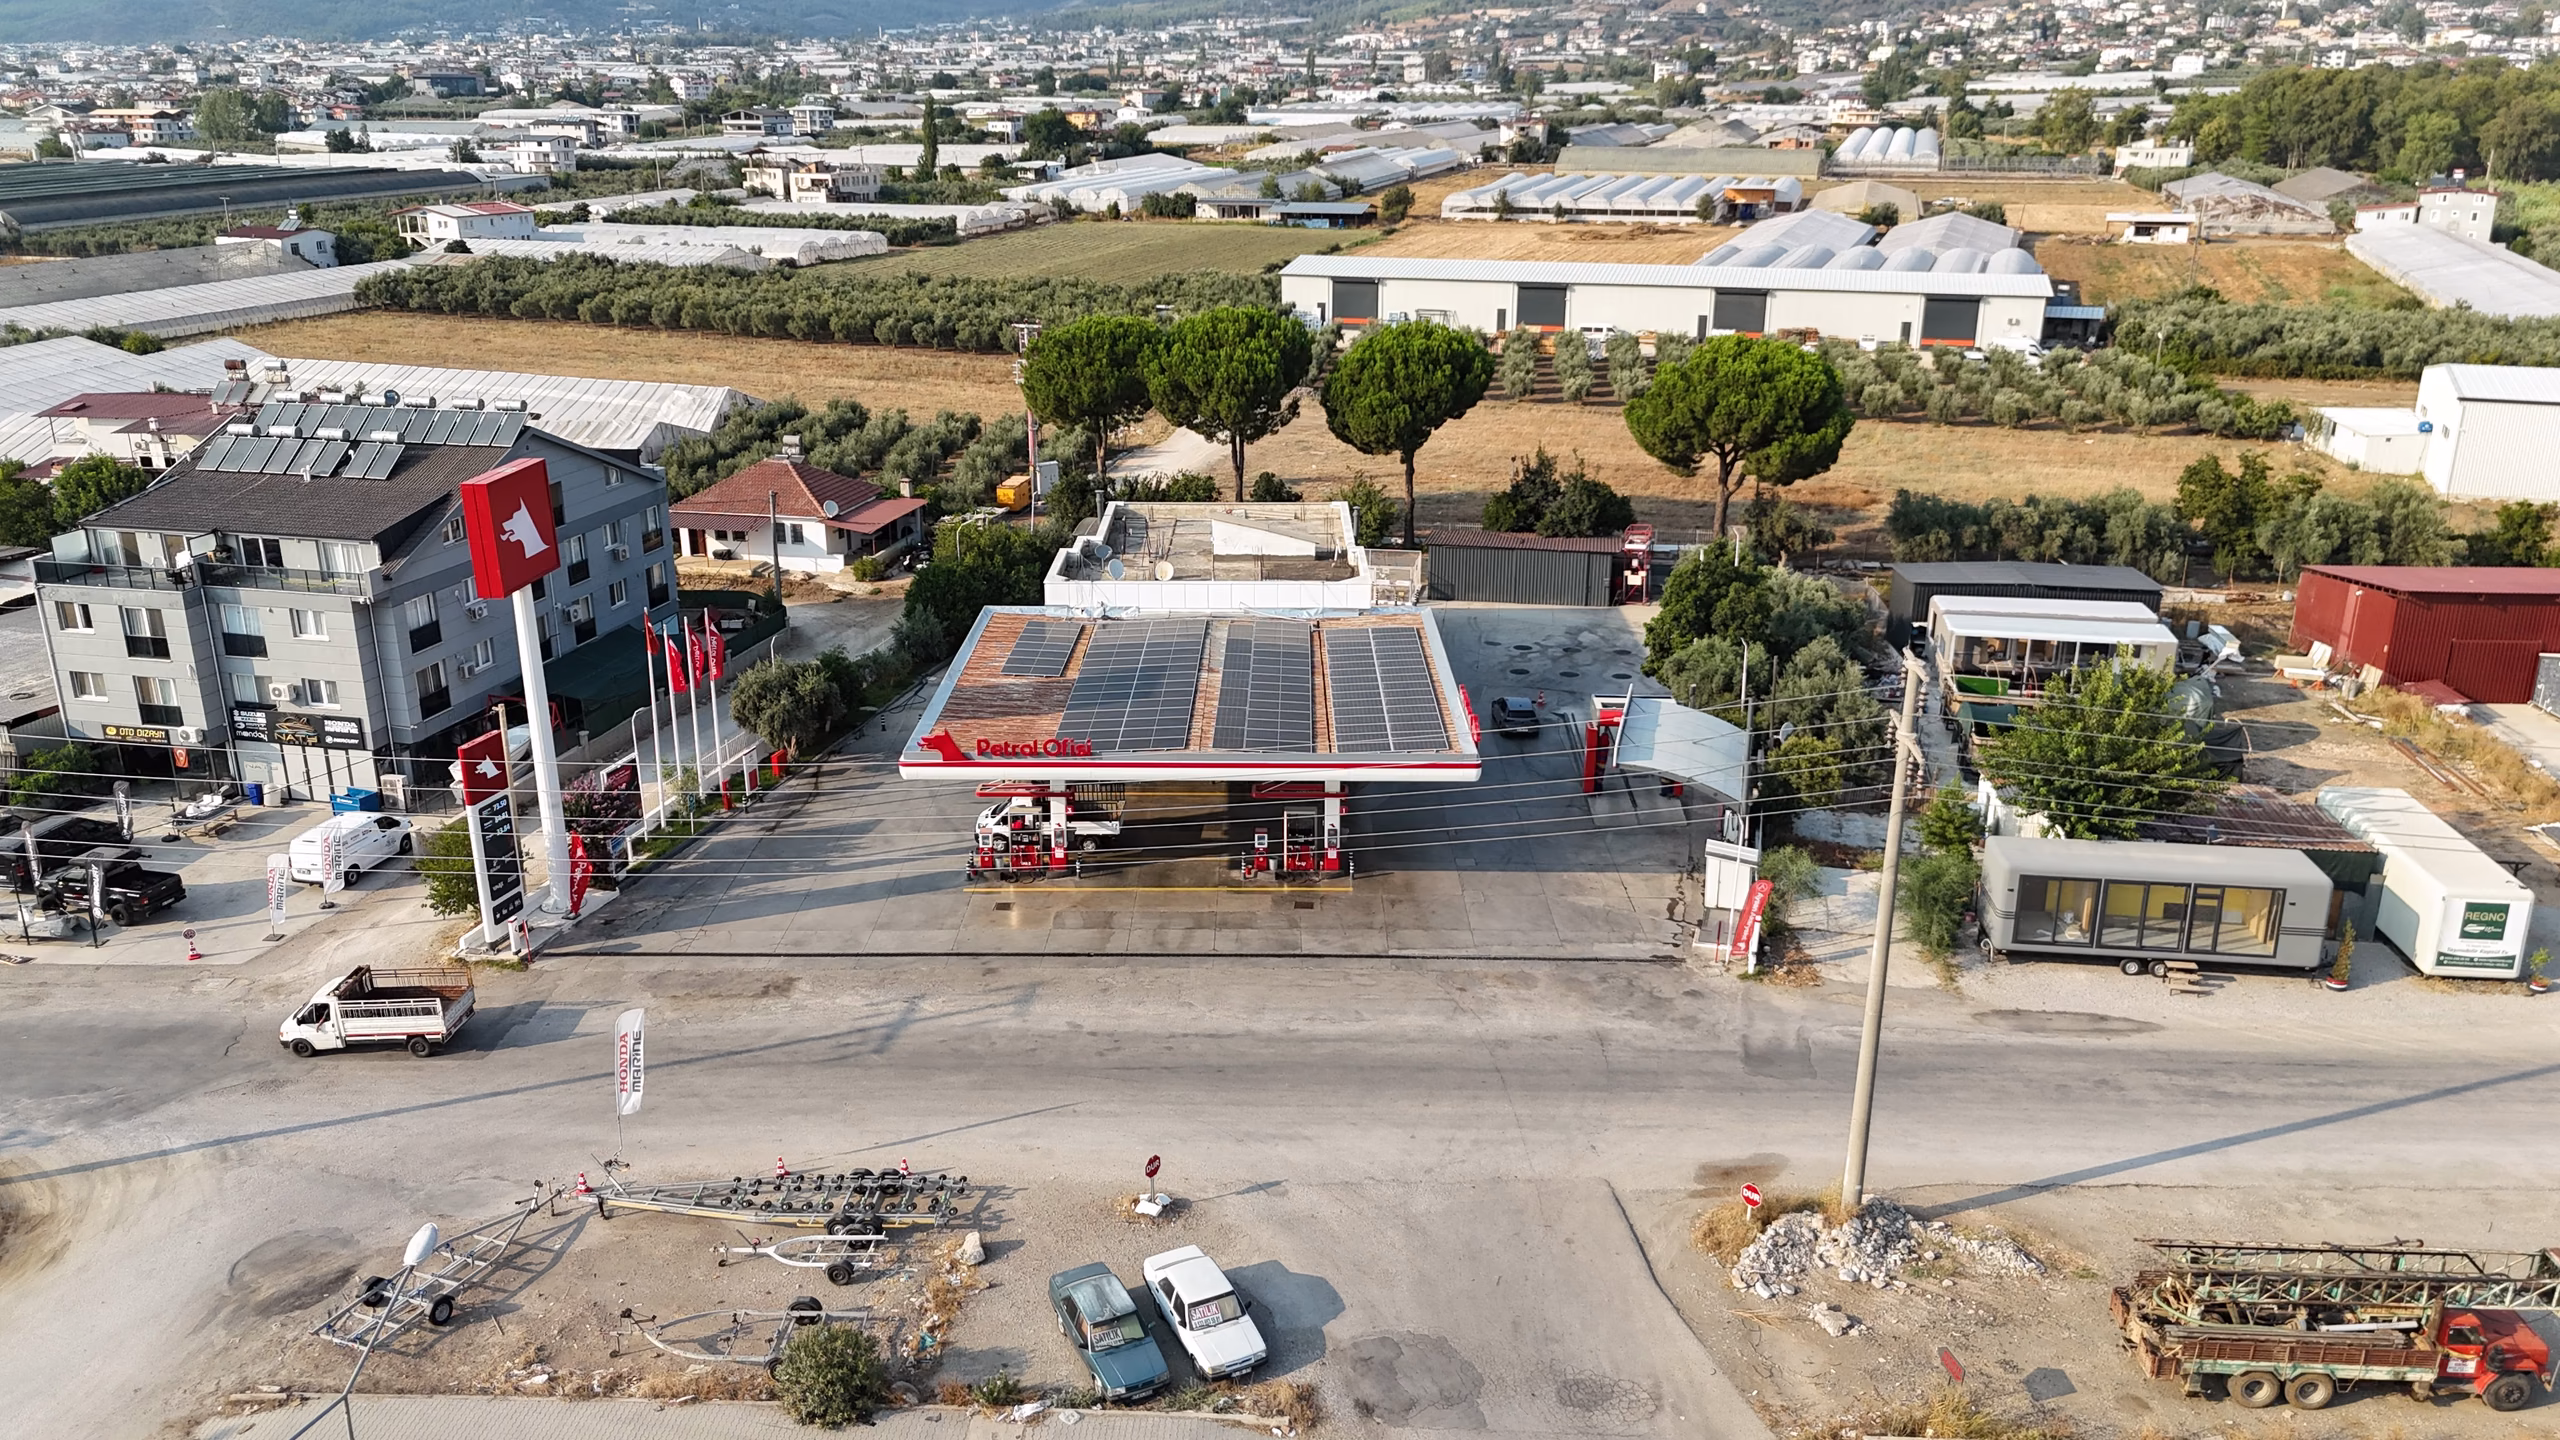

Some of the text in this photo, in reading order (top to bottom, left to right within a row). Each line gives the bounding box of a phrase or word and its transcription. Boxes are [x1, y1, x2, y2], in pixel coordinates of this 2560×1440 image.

[119, 728, 135, 736] OTO
[324, 719, 358, 728] HONDA
[976, 738, 1039, 757] Petrol
[323, 835, 332, 881] HONDA
[333, 835, 343, 880] MARINE
[276, 868, 286, 911] MARINE
[2464, 911, 2506, 922] REGNO
[619, 1031, 629, 1094] HONDA
[632, 1030, 642, 1093] MARINE
[1146, 1159, 1160, 1173] DUR
[1743, 1187, 1760, 1203] DUR
[1190, 1303, 1220, 1321] SATILIK
[1093, 1328, 1121, 1345] SATILIK
